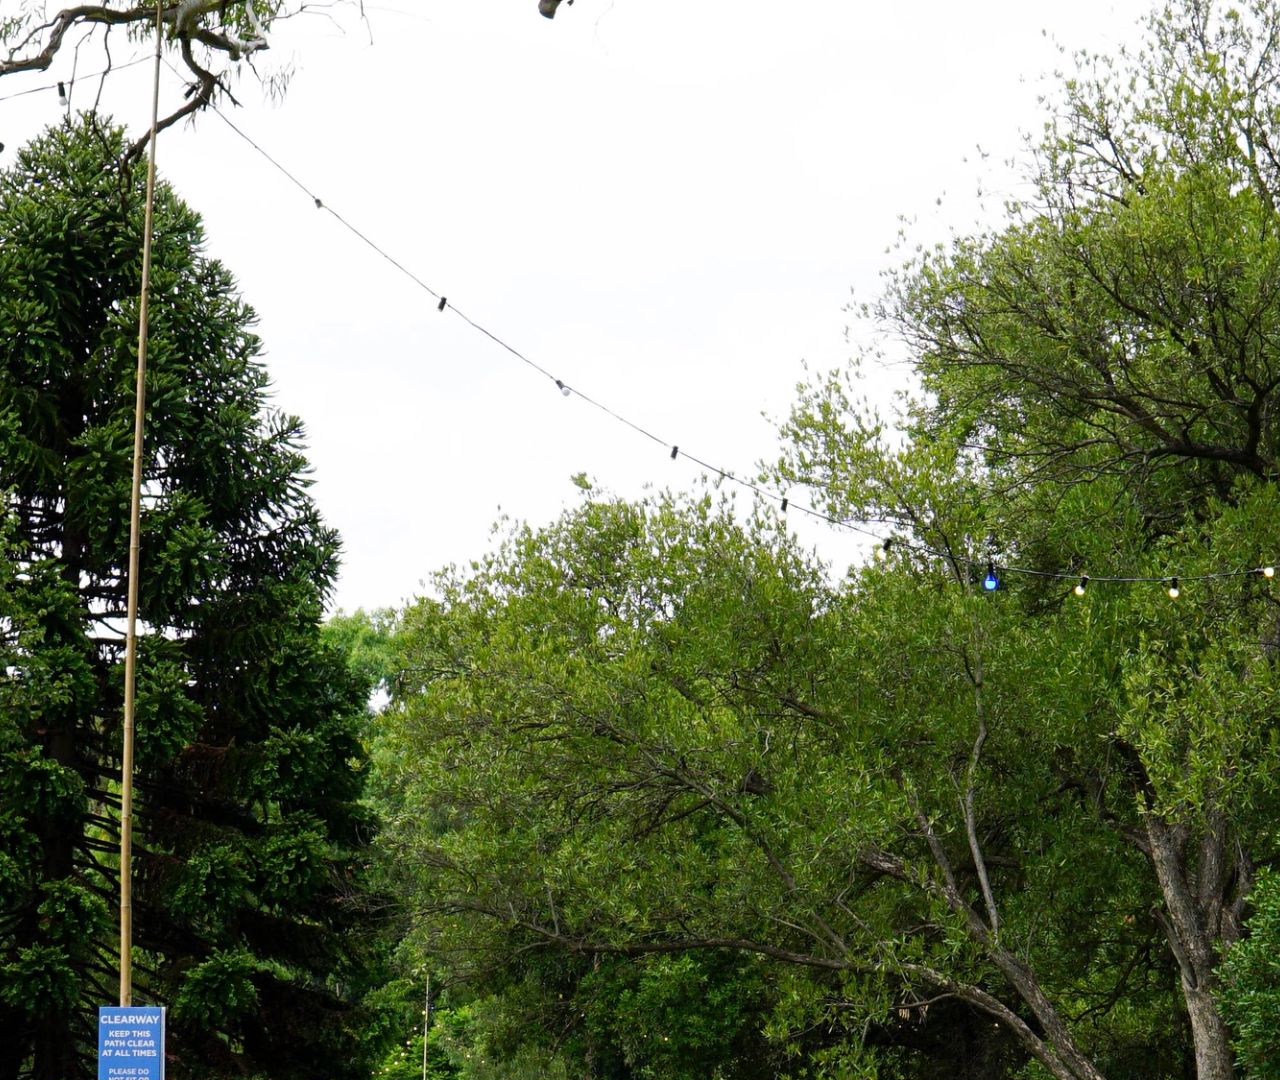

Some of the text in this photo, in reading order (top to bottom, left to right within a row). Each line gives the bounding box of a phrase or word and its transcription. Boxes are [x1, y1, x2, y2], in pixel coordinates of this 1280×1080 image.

[100, 1015, 160, 1024] CLEARWAY
[109, 1030, 151, 1038] KEEP THIS
